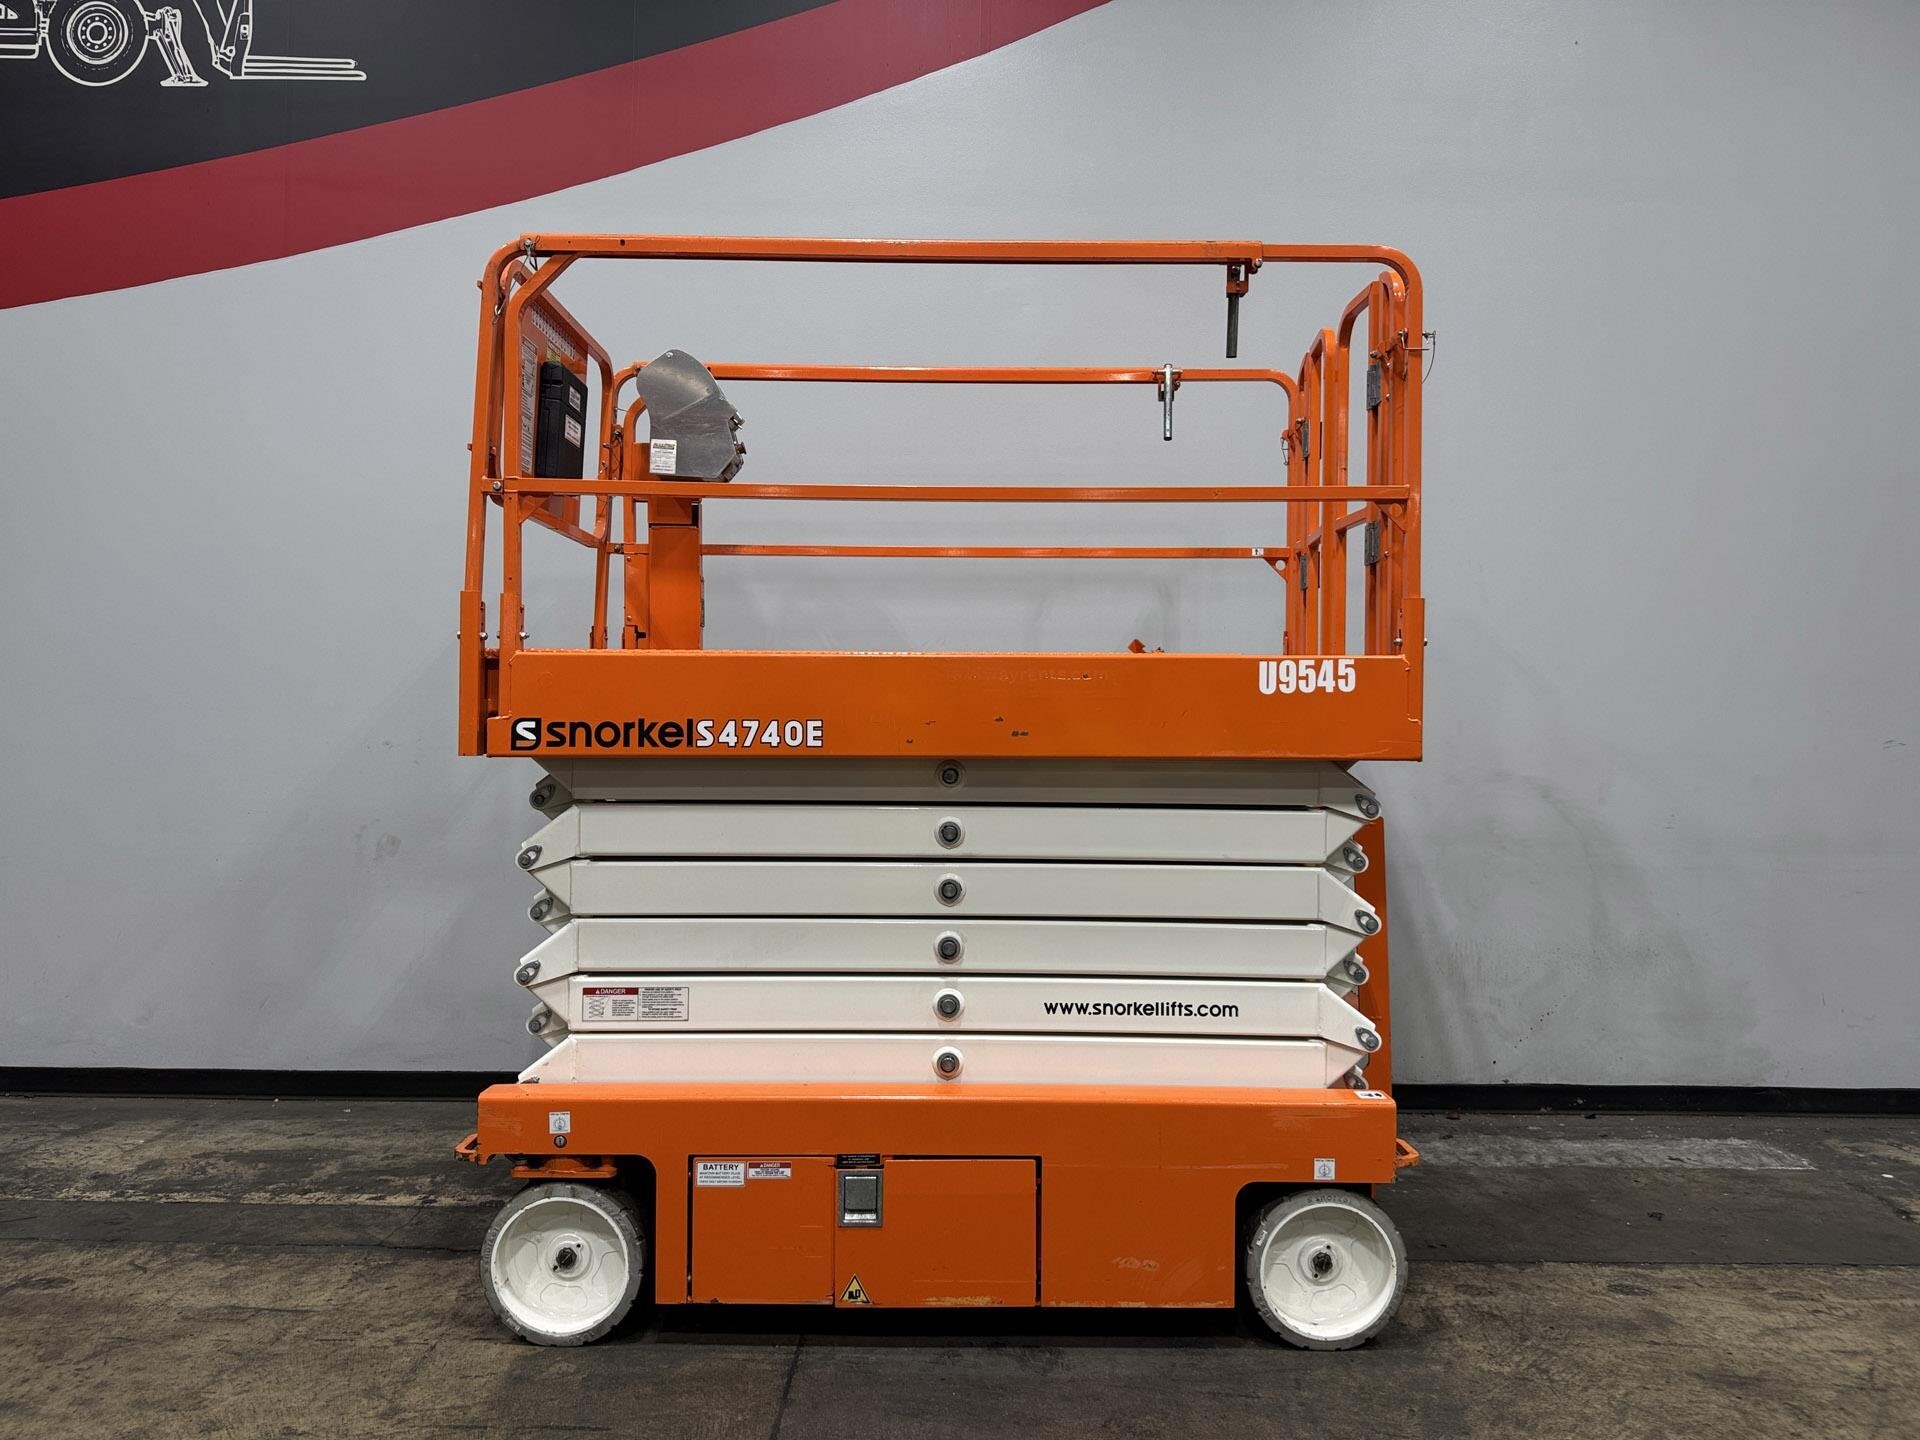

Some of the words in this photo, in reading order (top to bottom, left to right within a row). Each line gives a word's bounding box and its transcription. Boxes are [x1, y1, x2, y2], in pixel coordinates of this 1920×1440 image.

[1258, 658, 1357, 695] U9545
[546, 718, 693, 748] snorkel
[696, 719, 824, 748] S4740E
[1043, 1001, 1240, 1018] www.snorkellifts.com
[702, 1163, 740, 1171] BATTERY
